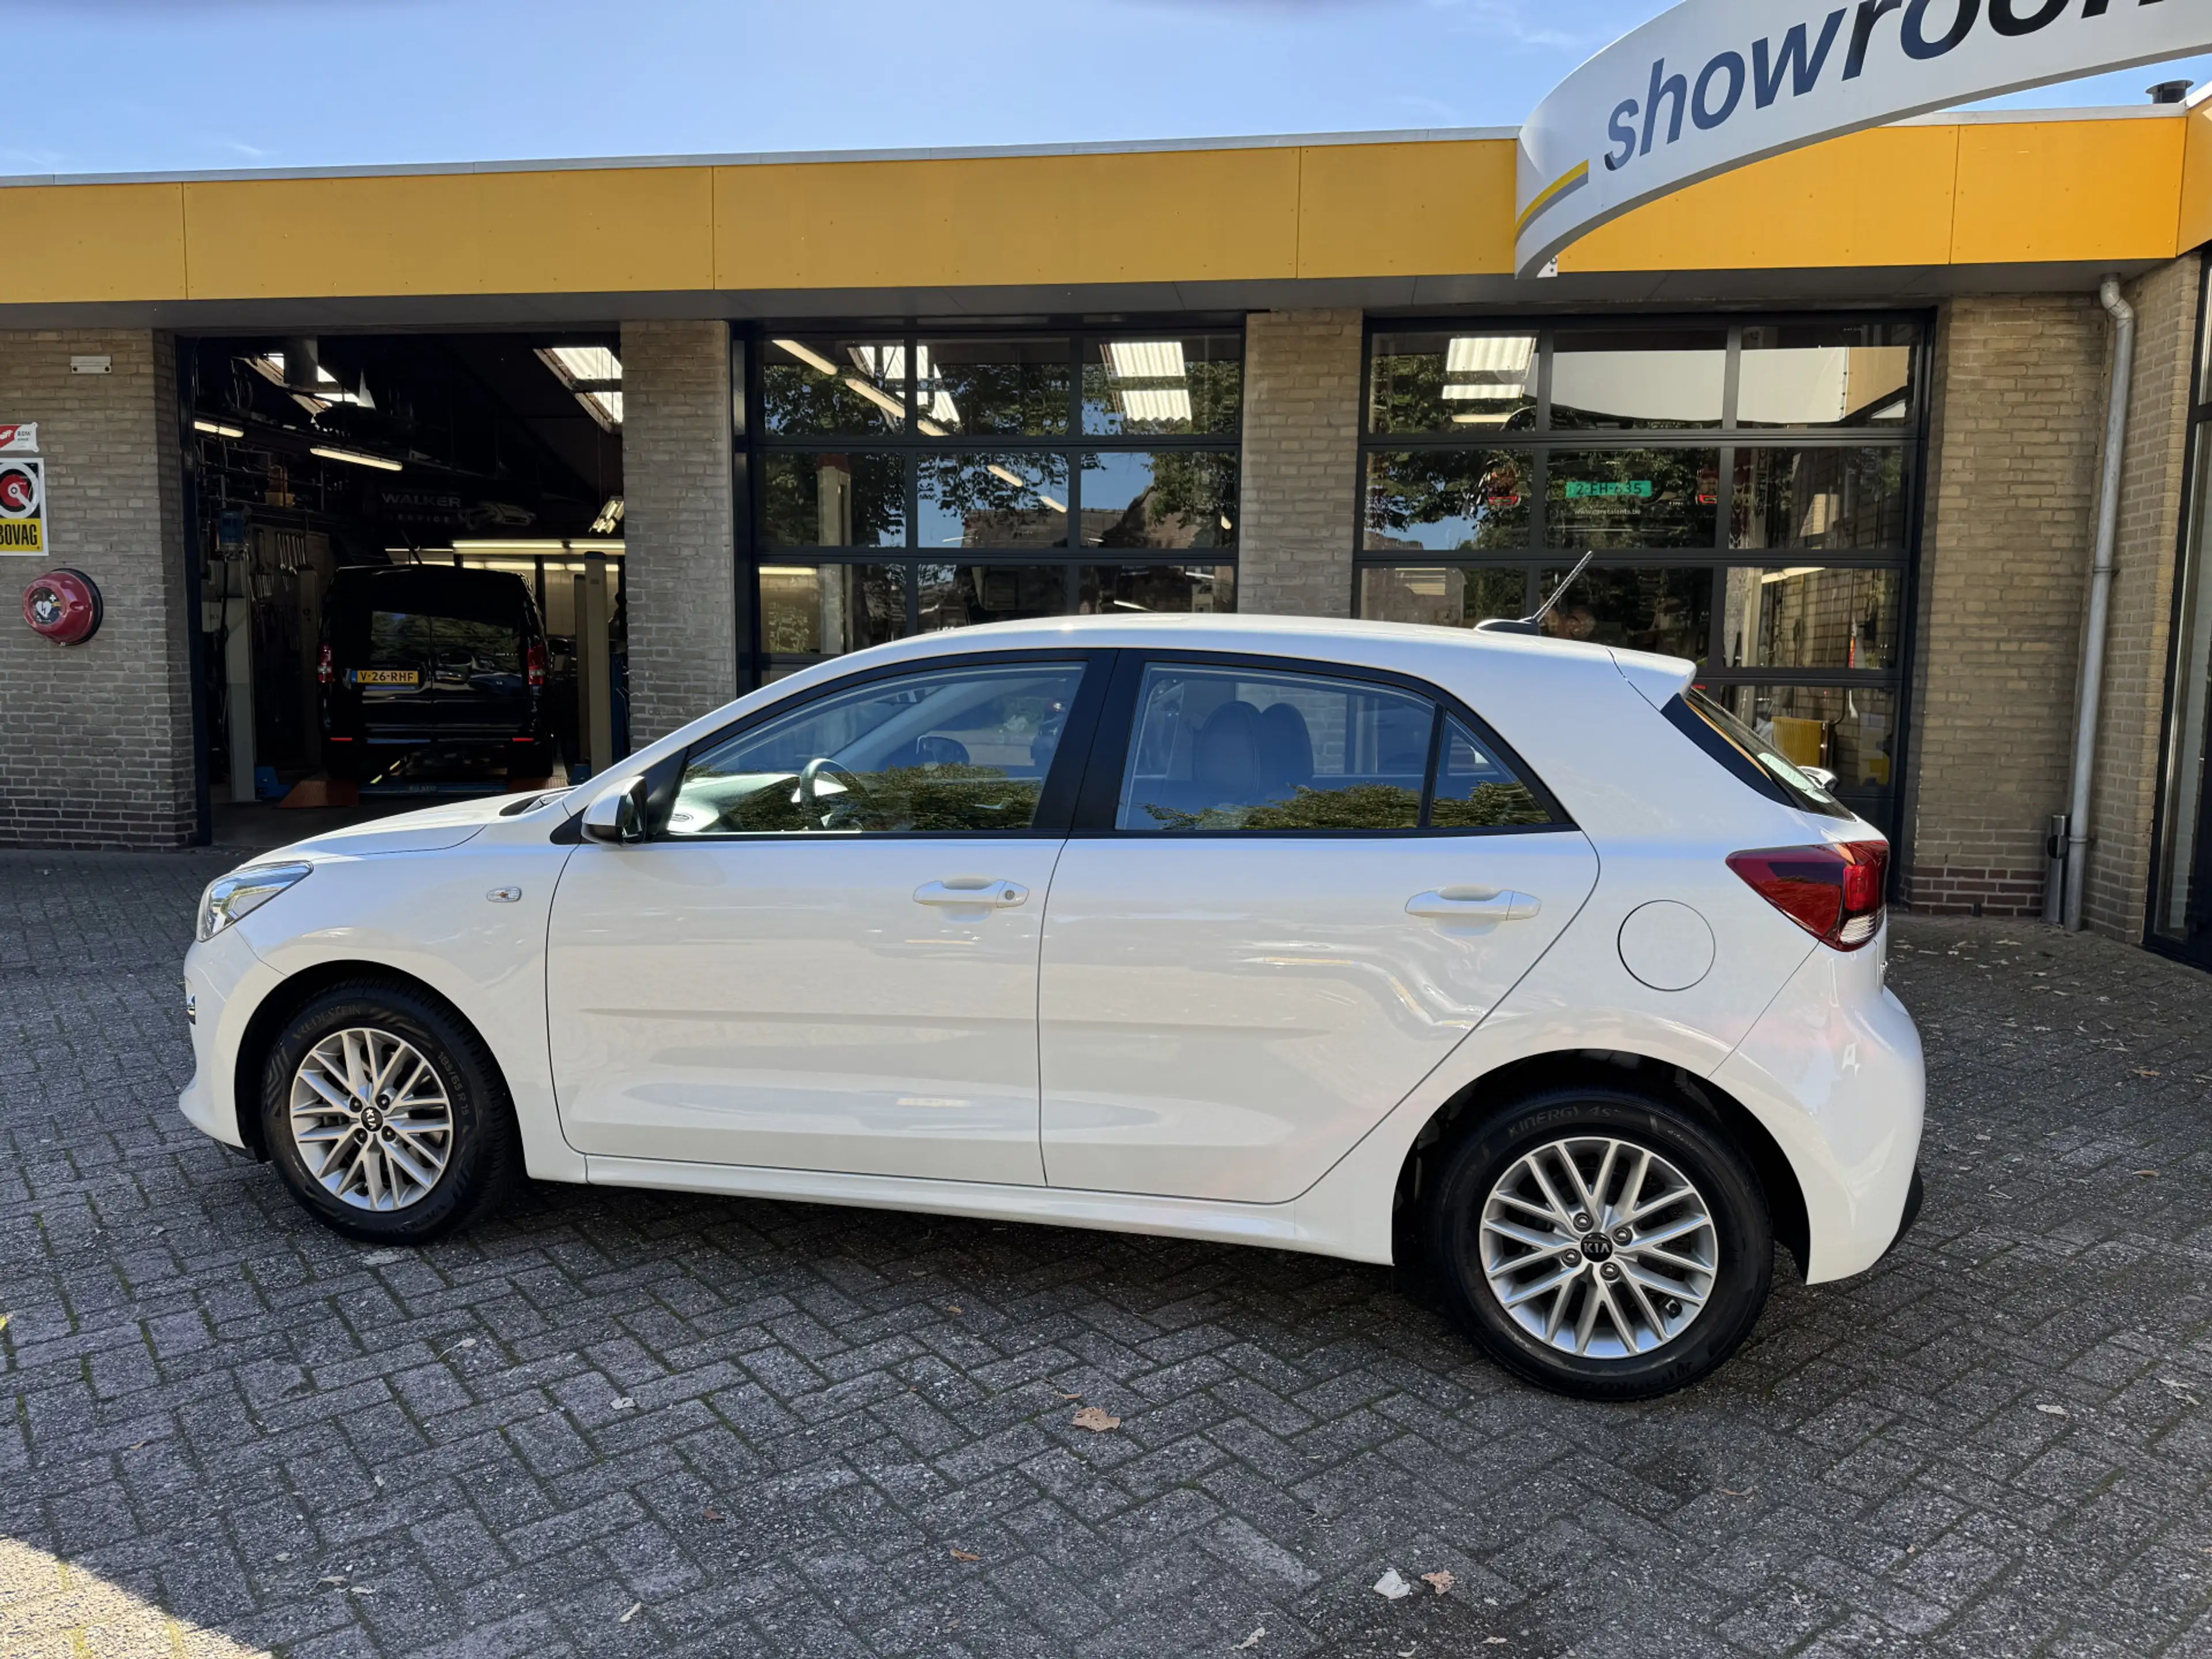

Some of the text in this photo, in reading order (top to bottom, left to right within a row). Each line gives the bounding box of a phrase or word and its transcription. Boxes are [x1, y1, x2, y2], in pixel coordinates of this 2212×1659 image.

[381, 493, 461, 509] WALKER
[360, 672, 414, 681] V-26-RHF
[437, 1051, 463, 1093] 185/65
[366, 1108, 377, 1129] KIA
[1582, 1243, 1611, 1253] KIA
